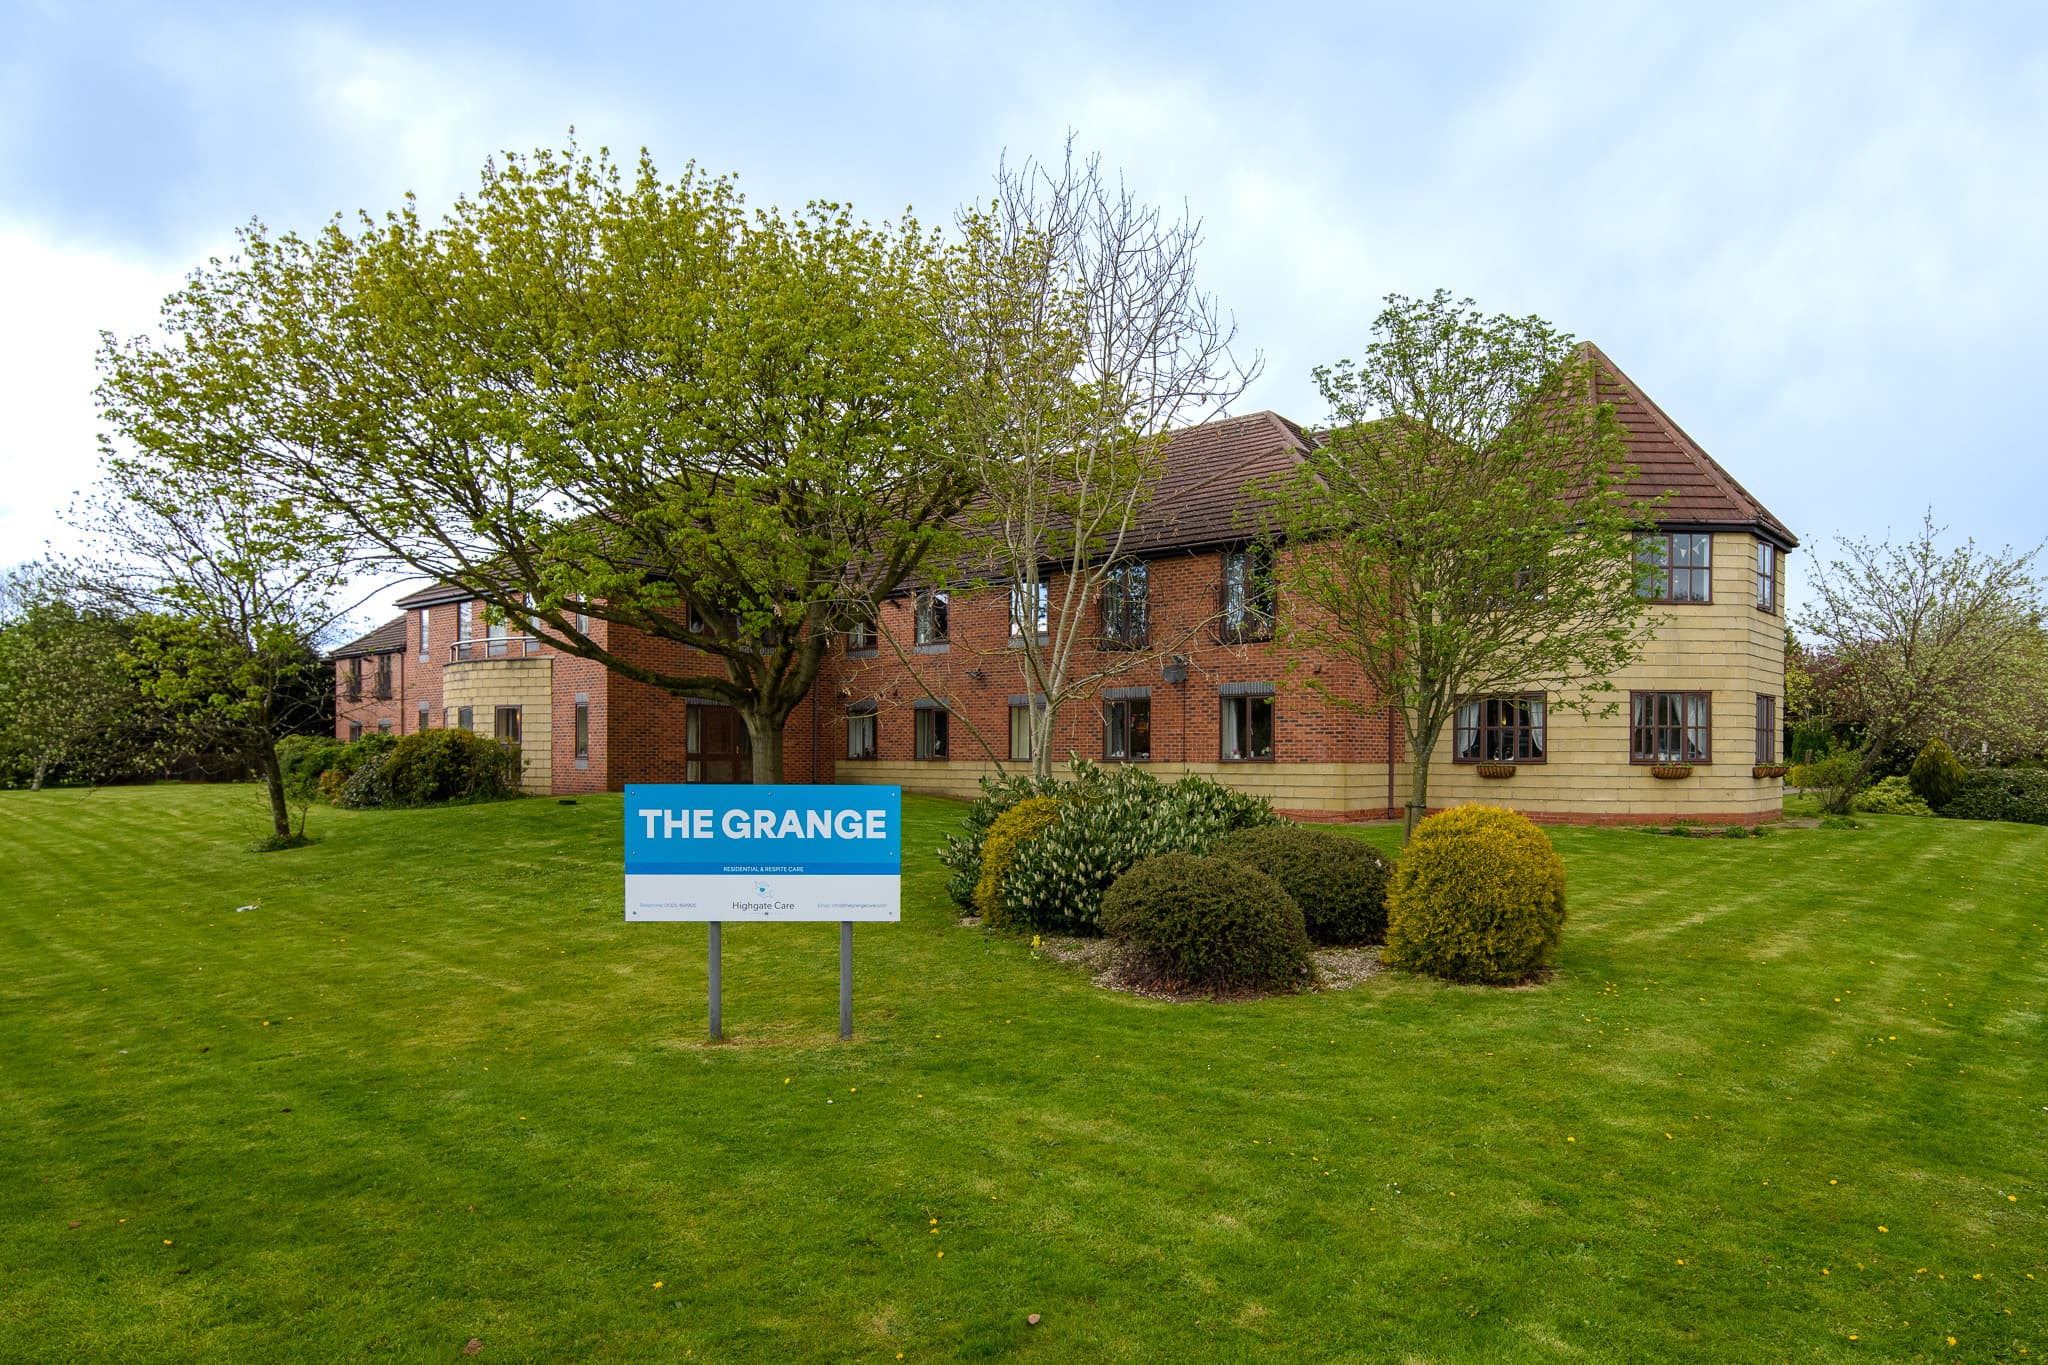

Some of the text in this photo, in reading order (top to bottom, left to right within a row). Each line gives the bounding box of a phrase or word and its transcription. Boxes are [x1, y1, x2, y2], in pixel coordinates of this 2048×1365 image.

[638, 808, 887, 840] THE GRANGE
[732, 901, 795, 911] Highgate Care
